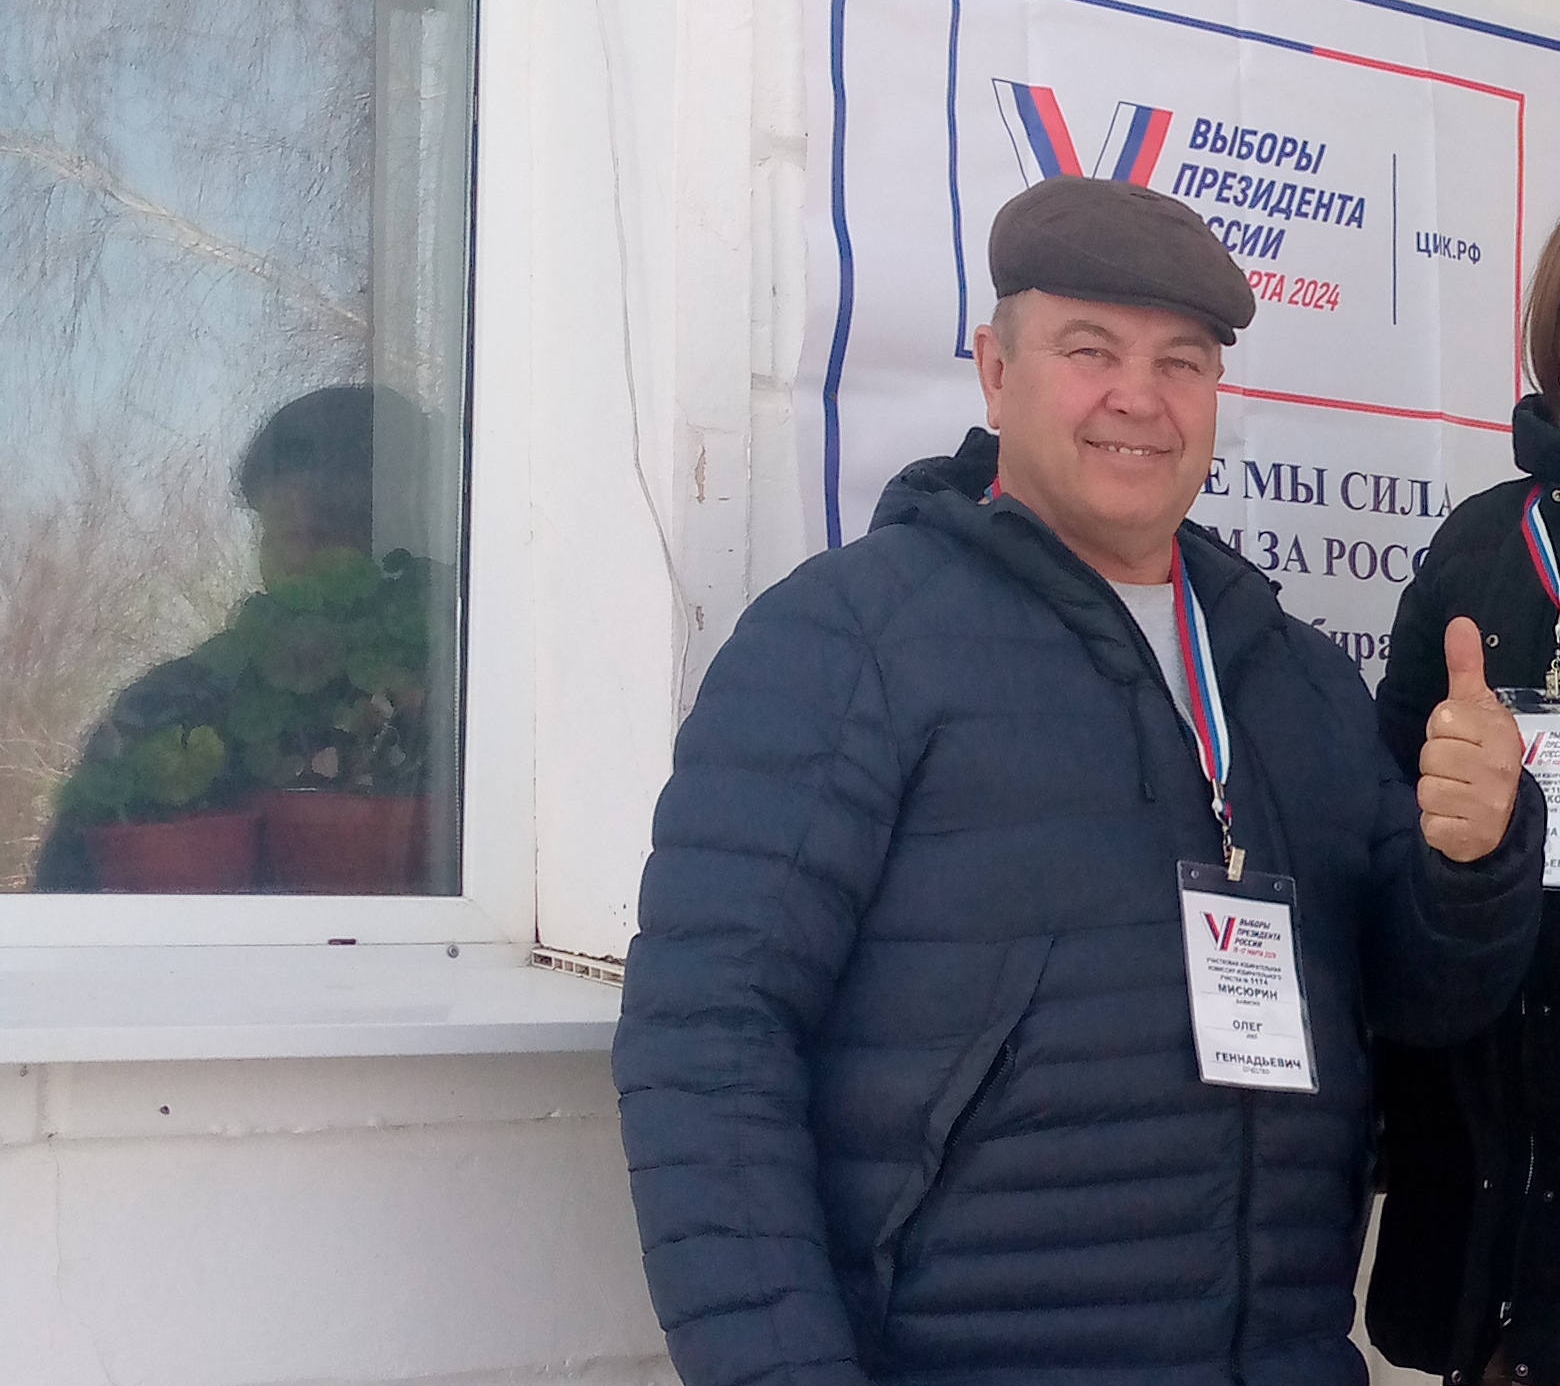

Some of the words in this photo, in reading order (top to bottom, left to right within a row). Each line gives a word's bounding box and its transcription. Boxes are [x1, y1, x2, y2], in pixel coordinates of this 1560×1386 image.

[1189, 117, 1327, 175] ВЫБОРЫ
[1172, 162, 1367, 229] ПРЕЗИДЕНТА
[1206, 215, 1287, 261] ССИИ
[1415, 231, 1482, 265] ЦИК.РФ
[1247, 269, 1287, 304] РТА
[1288, 277, 1342, 312] 2024
[1240, 459, 1330, 507] МЫ
[1340, 471, 1453, 519] СИЛА
[1256, 529, 1312, 574] ЗА
[1322, 537, 1432, 583] РОСС
[1217, 983, 1278, 1001] МИСЮРИН
[1251, 977, 1269, 986] 1174
[1232, 1019, 1264, 1033] ОЛЕГ
[1215, 1051, 1302, 1070] ГЕННАДЬЕВИЧ
